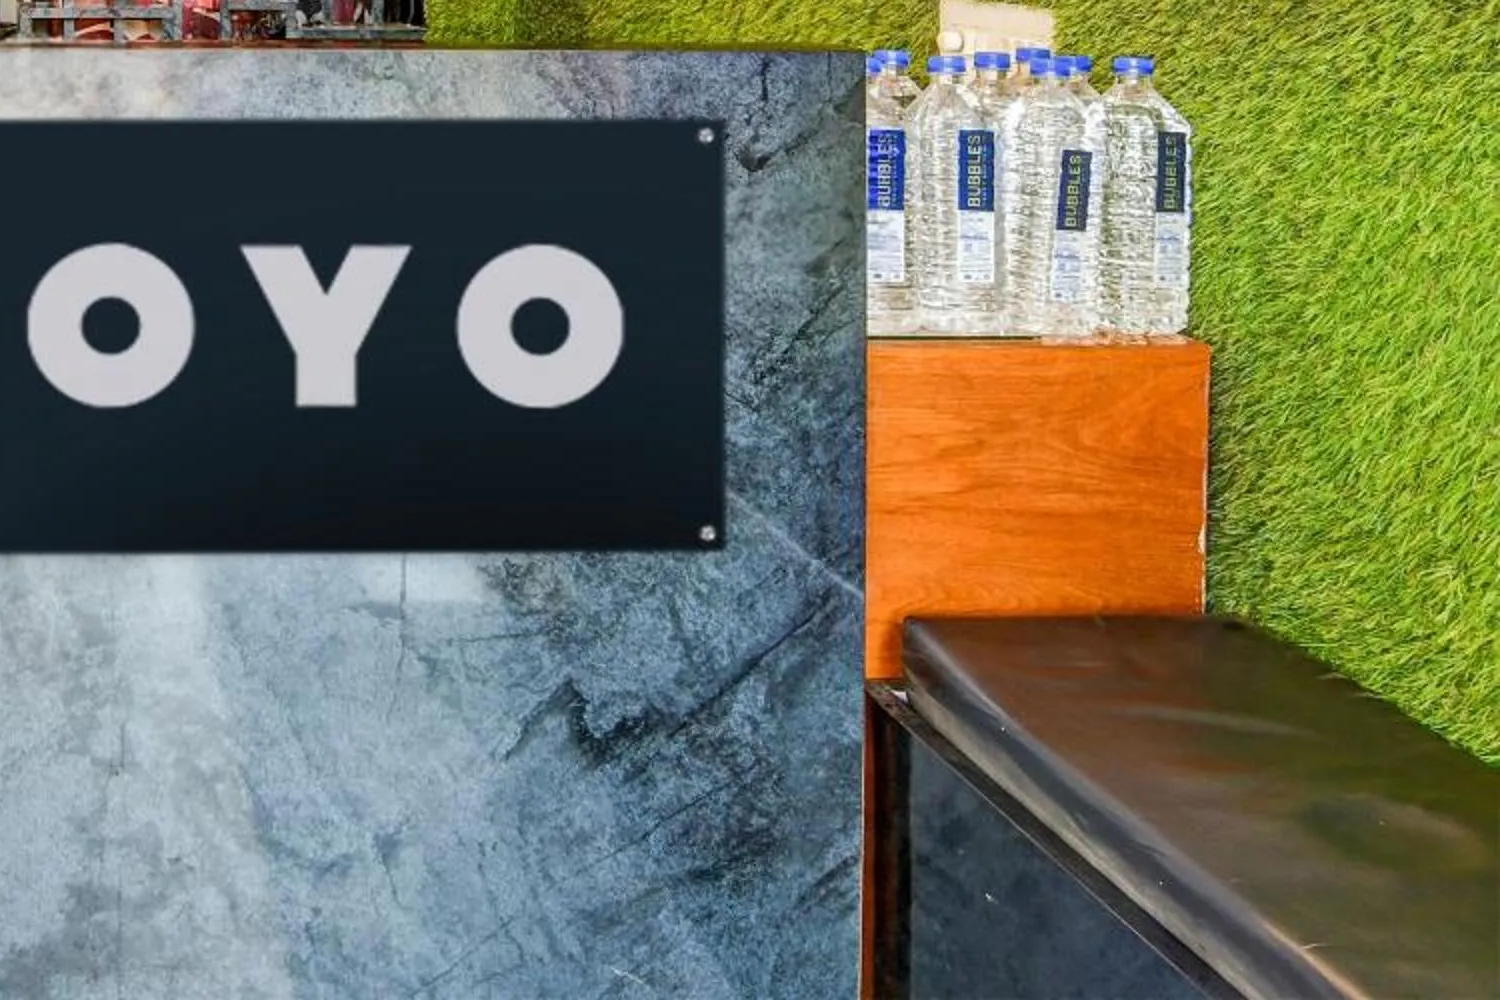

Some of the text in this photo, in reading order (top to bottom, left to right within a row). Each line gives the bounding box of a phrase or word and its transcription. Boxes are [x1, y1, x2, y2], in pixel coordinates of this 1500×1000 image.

[967, 135, 981, 208] BUBBLES
[1064, 155, 1082, 228] BUBBLES
[1164, 135, 1177, 210] BUBBLES
[27, 243, 623, 408] OYO
